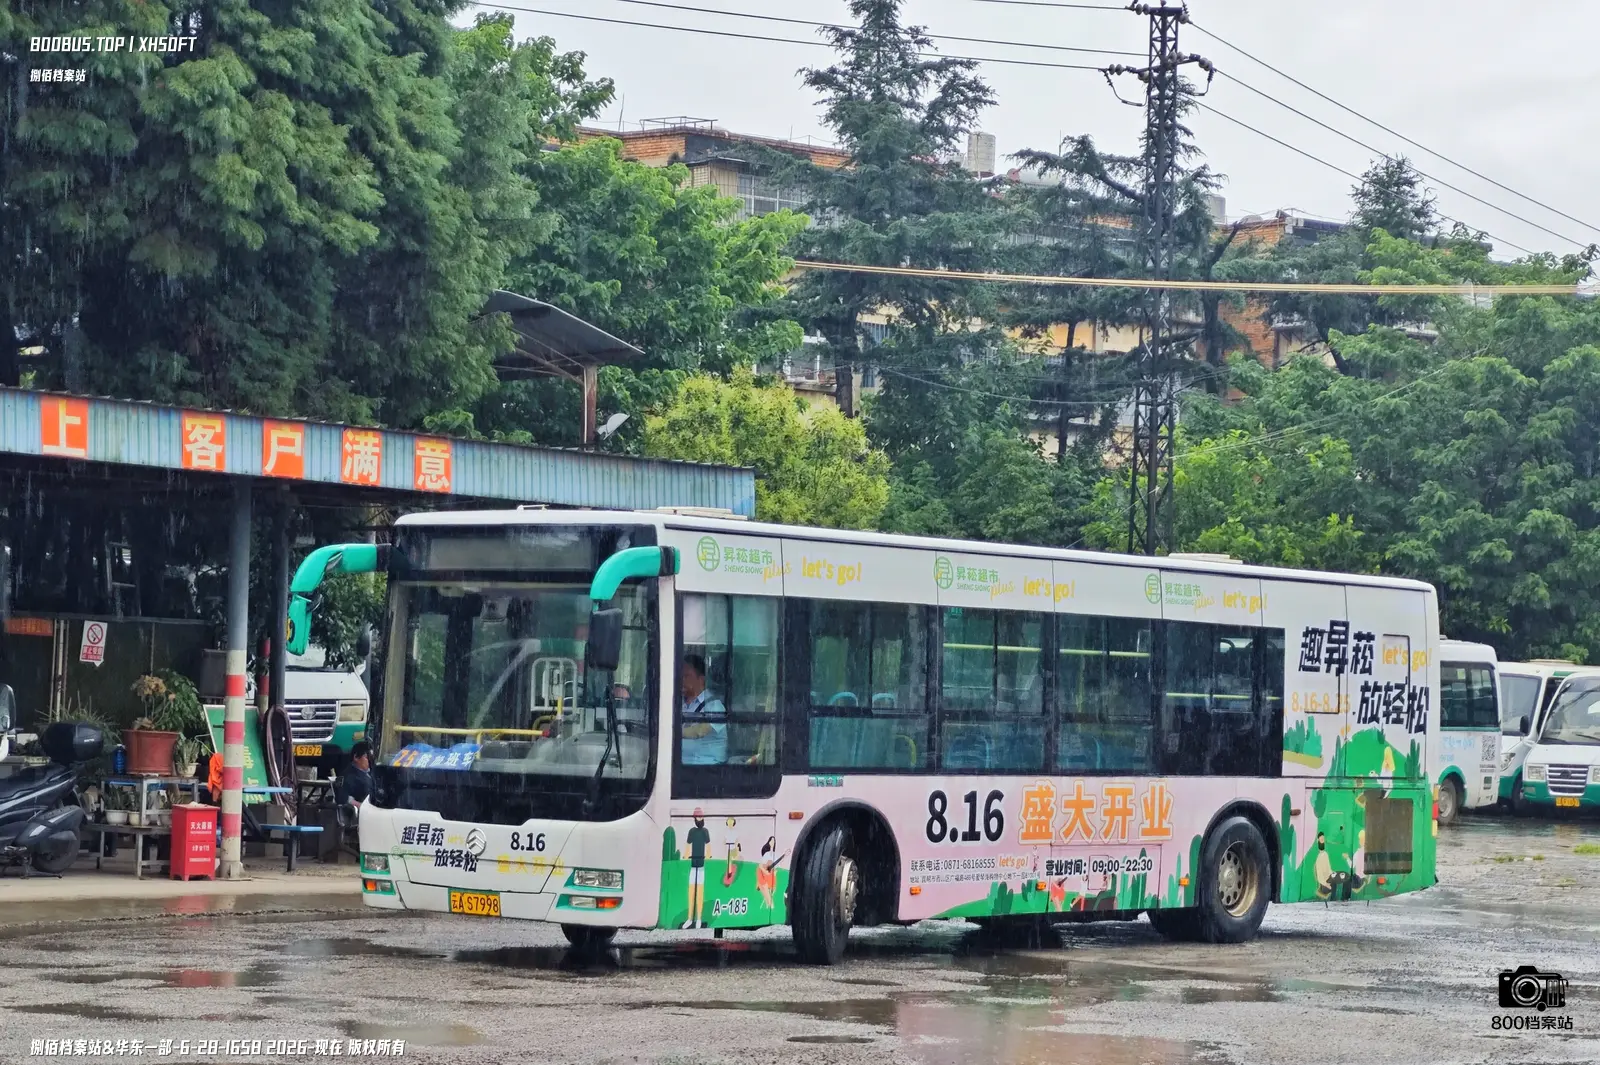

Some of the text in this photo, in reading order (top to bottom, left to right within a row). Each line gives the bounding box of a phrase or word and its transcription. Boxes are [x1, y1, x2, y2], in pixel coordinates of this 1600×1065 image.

[184, 413, 452, 492] 客户满意
[724, 564, 764, 575] SHENG SIONG
[763, 560, 792, 584] plus
[802, 556, 862, 586] let's go!
[990, 578, 1015, 601] plus
[1023, 575, 1076, 603] let's go!
[1223, 590, 1268, 614] let's go!
[1382, 643, 1433, 673] let's go!
[1356, 677, 1430, 735] 放轻松
[926, 788, 1005, 844] 8.16
[1019, 780, 1174, 844] 盛大开业
[510, 831, 546, 852] 8.16
[433, 848, 480, 873] 放轻松
[496, 853, 565, 876] 盛大开业
[998, 855, 1015, 868] let's
[1092, 858, 1153, 873] 09:00-22:30
[712, 898, 748, 915] A-185
